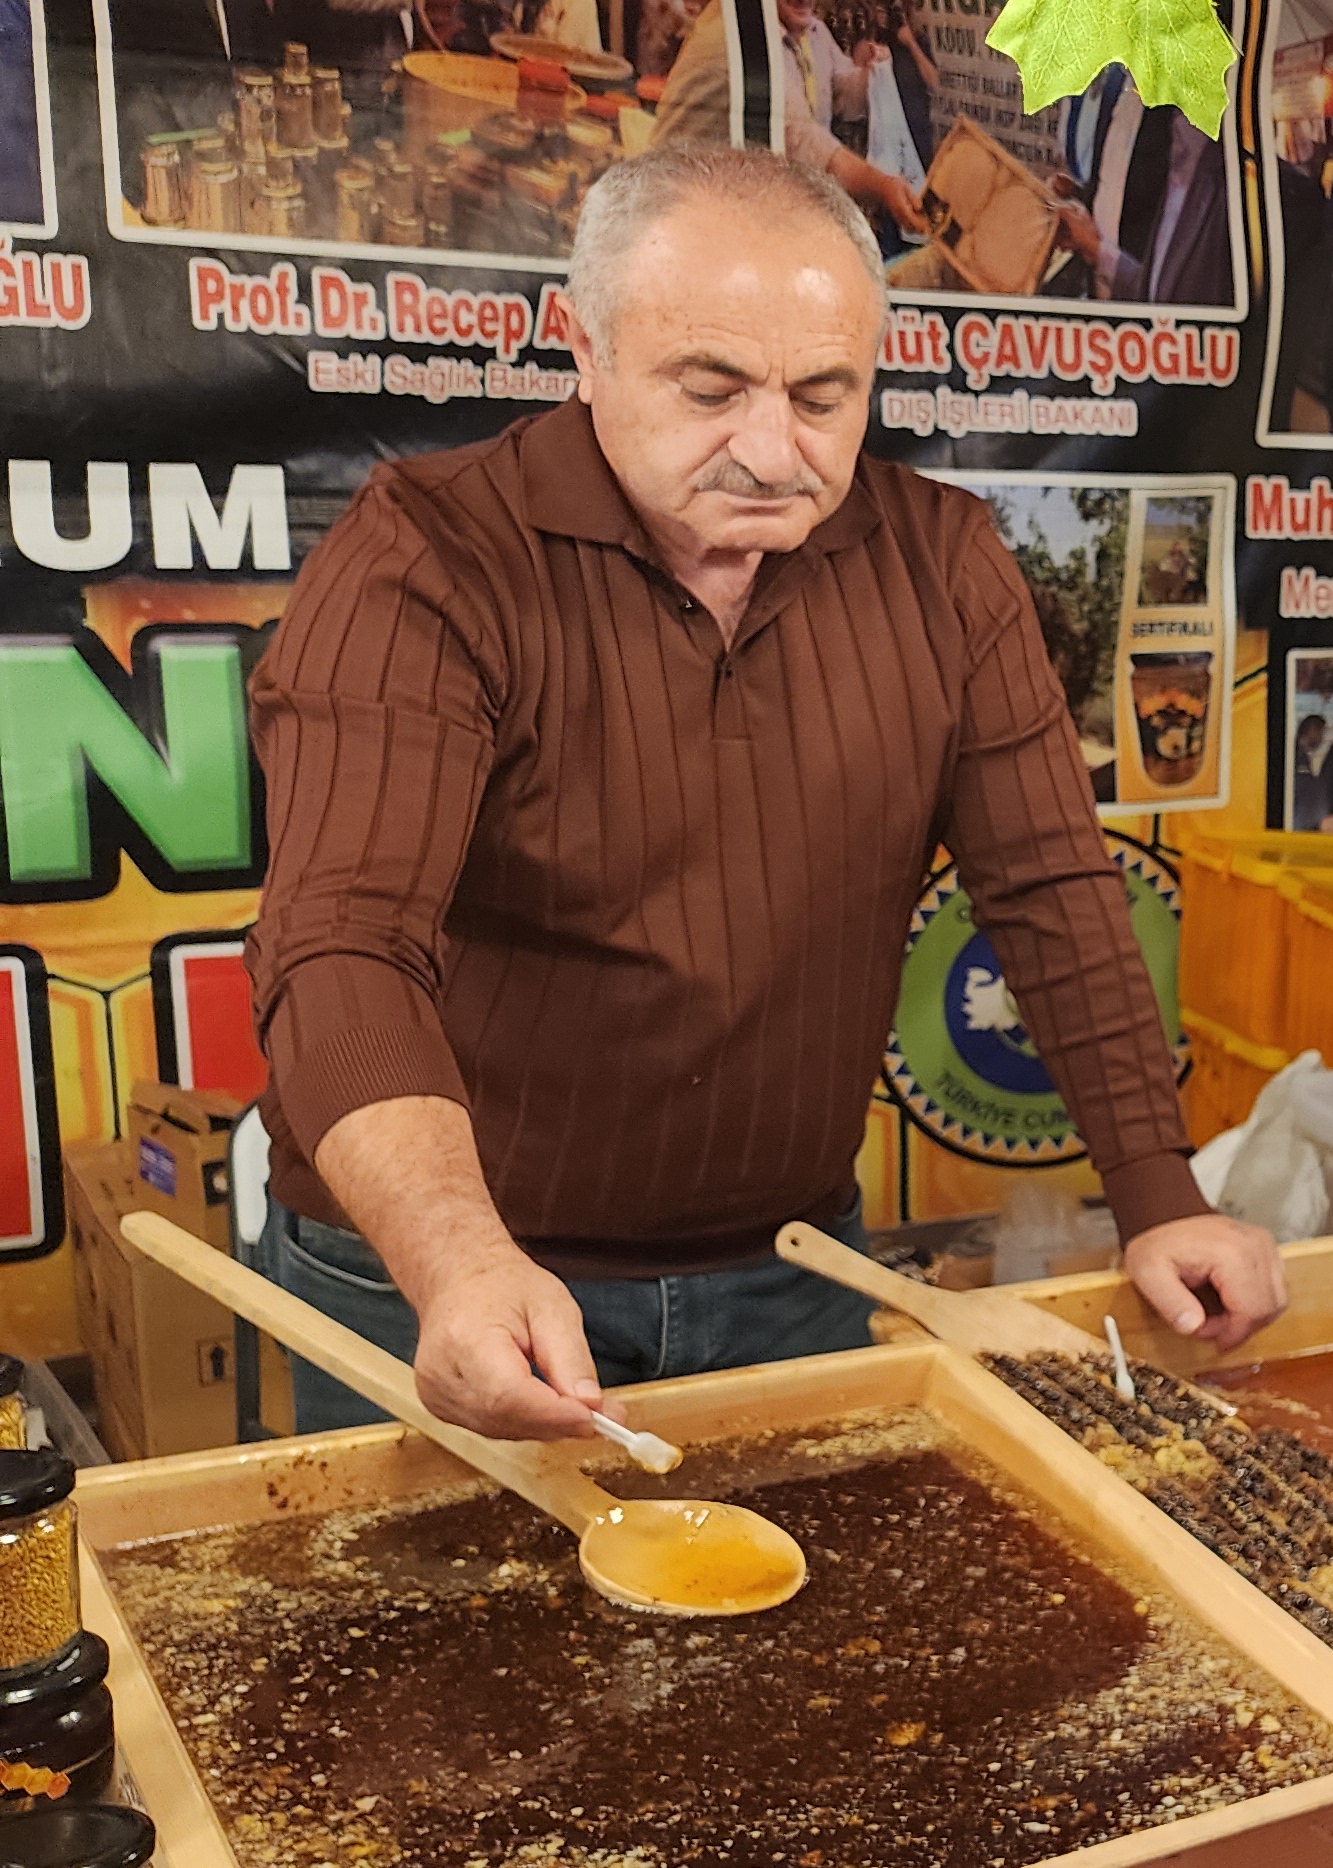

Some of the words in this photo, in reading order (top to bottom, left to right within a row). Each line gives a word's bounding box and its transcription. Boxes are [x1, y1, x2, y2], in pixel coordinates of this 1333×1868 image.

[194, 263, 306, 329] Prof.
[316, 273, 380, 333] Dr.
[391, 278, 528, 355] Recep
[313, 353, 378, 390] Eski
[388, 358, 483, 399] Sağlık
[959, 316, 1237, 389] ÇAVUŞOĞLU
[887, 394, 933, 430] DIŞ
[939, 389, 1030, 433] İŞLERİ
[1033, 402, 1135, 434] BAKANI
